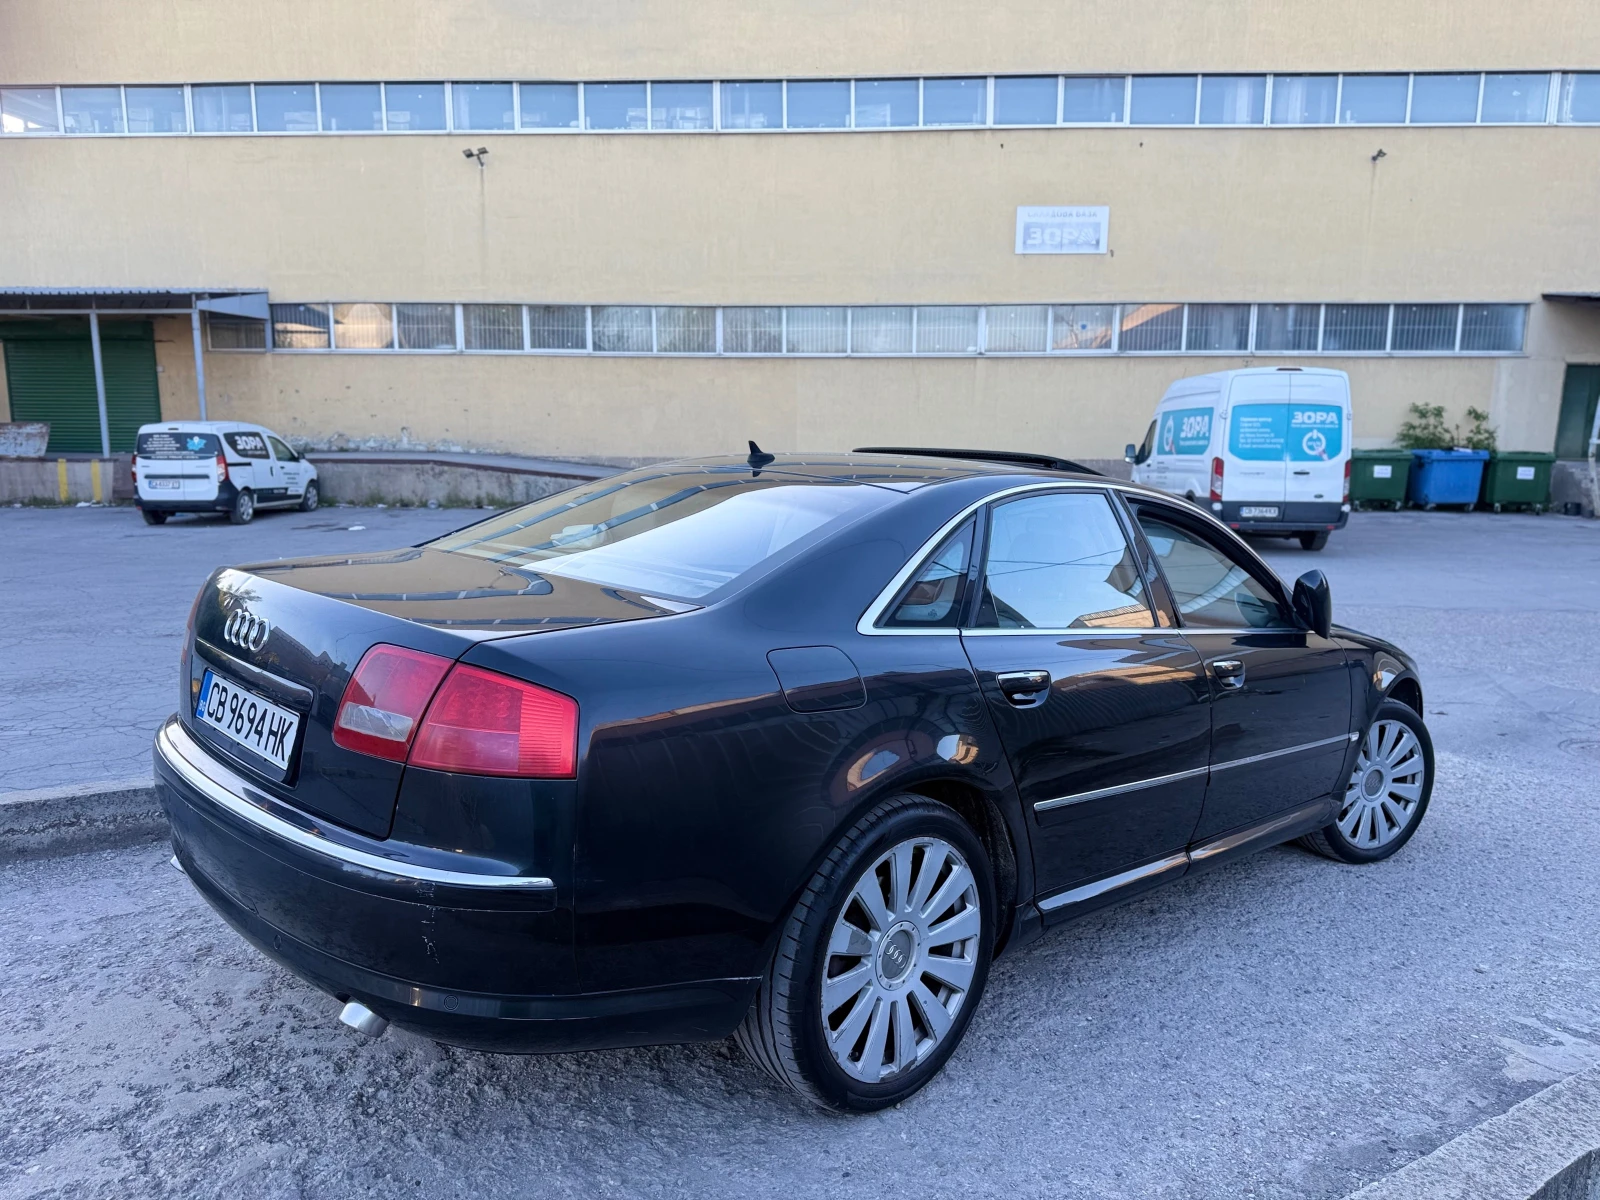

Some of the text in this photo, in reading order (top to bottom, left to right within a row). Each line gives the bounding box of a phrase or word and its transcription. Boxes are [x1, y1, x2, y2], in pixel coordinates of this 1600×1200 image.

[1027, 227, 1097, 245] ЗОРА
[1291, 411, 1339, 424] ЗОРА
[1180, 415, 1209, 438] ЗОРА
[235, 435, 265, 450] ЗОРА
